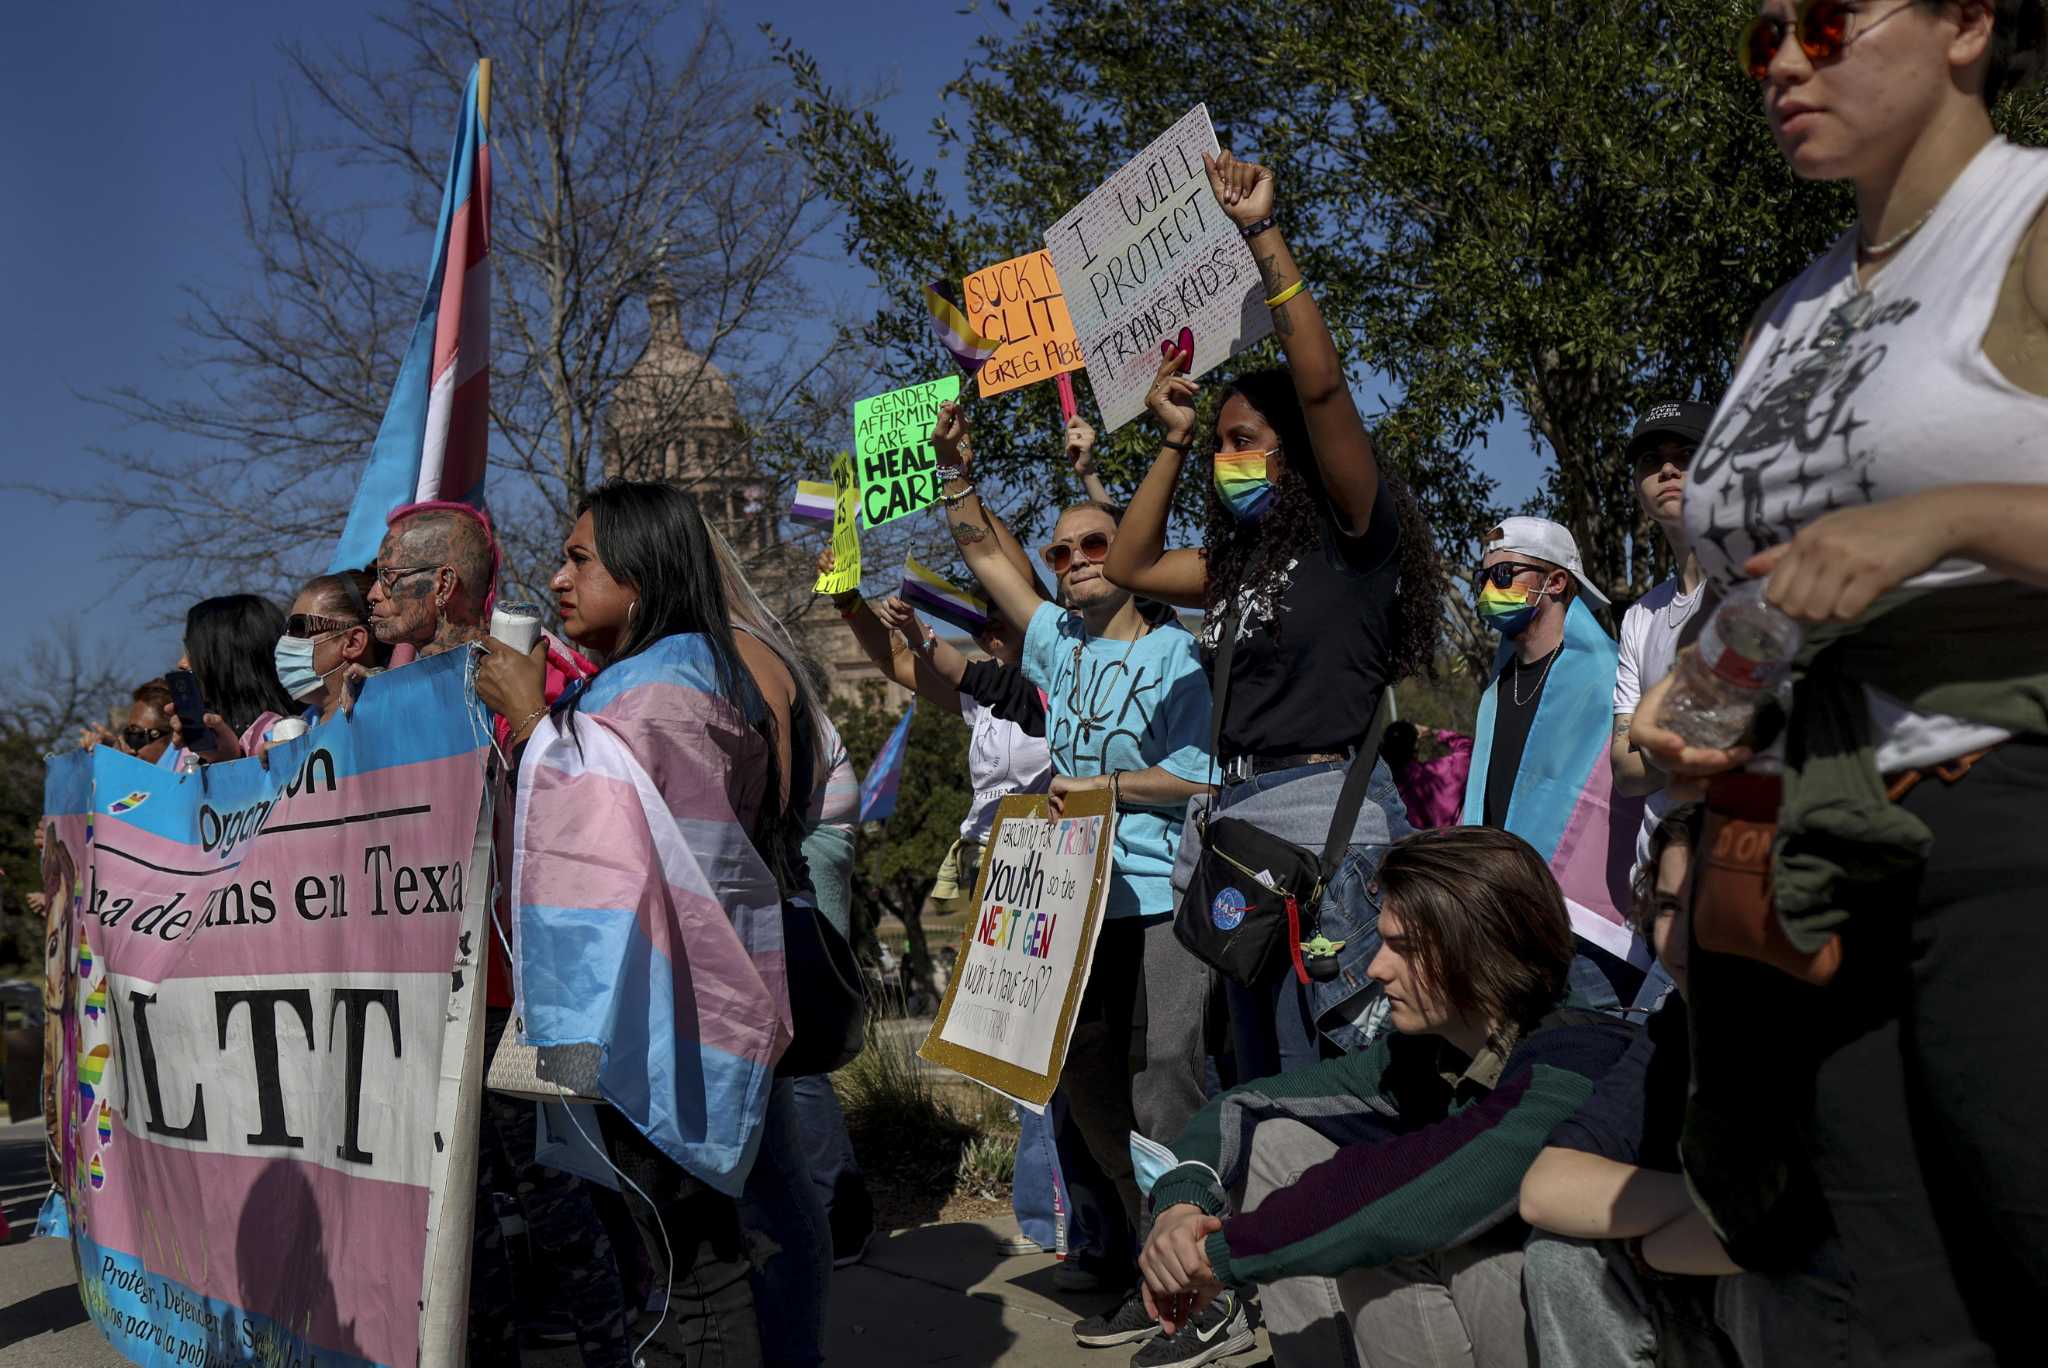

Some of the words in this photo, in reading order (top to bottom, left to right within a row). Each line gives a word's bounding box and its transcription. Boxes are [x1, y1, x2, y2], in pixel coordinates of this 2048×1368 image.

[1067, 216, 1099, 271] I
[1117, 144, 1206, 227] WILL
[1089, 187, 1207, 320] PROTECT
[967, 254, 1038, 313] SUCK
[982, 293, 1064, 347] CLIT
[1092, 298, 1177, 381] TRANS
[1179, 247, 1238, 312] KIDS
[981, 349, 1040, 387] GREG
[1046, 338, 1085, 367] ABB
[858, 401, 940, 438] AFFIRMIN
[870, 383, 939, 415] GENDER
[864, 427, 909, 455] CARE
[916, 421, 935, 444] I
[131, 892, 192, 942] de
[294, 872, 347, 921] en
[363, 844, 464, 916] Texa
[977, 905, 1022, 951] NEXT
[1022, 911, 1057, 960] GEN
